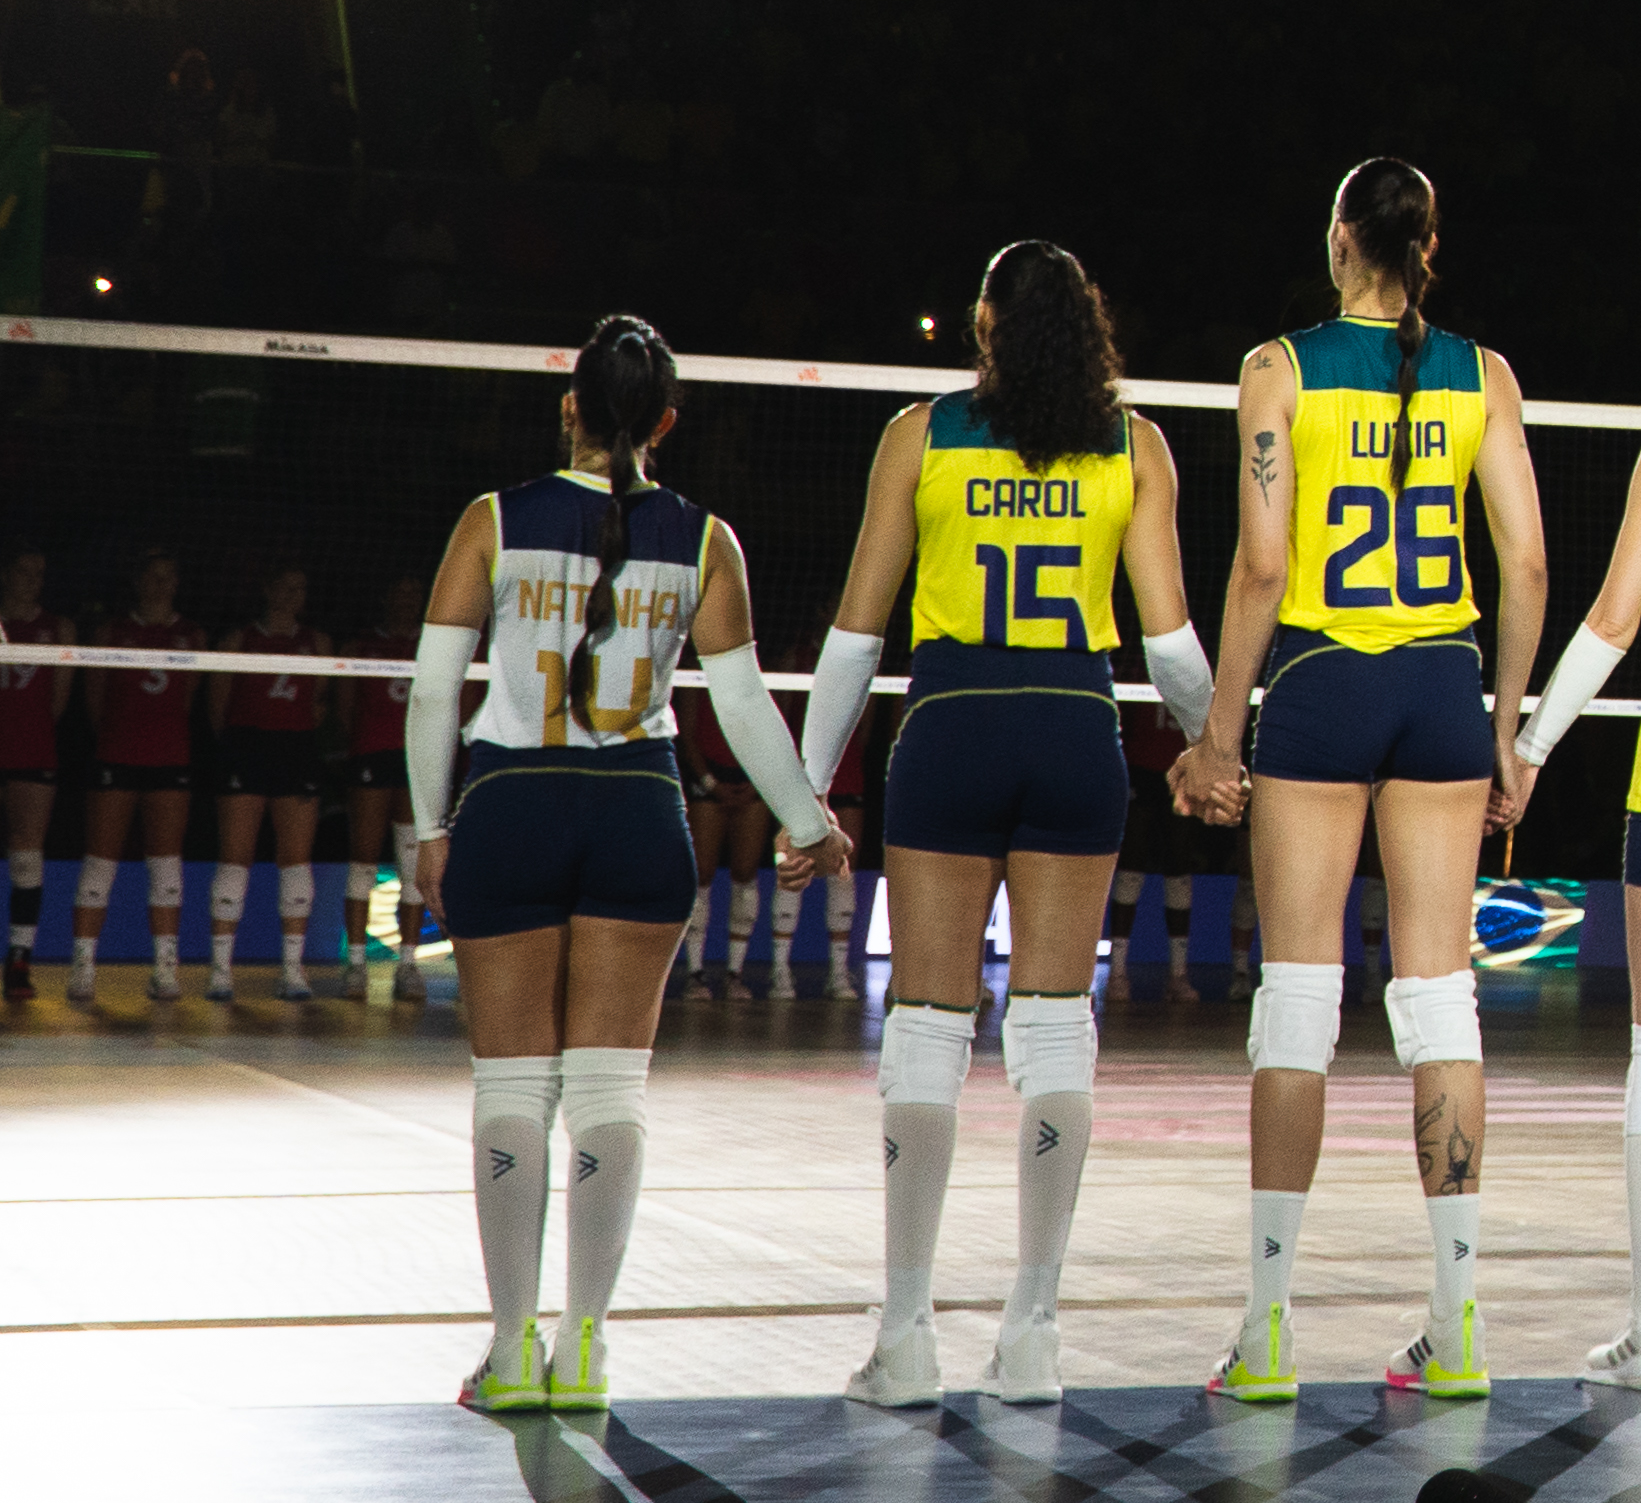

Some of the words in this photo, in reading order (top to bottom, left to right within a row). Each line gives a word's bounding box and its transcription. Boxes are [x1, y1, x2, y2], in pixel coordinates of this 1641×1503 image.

[1352, 420, 1447, 459] LUIA
[966, 478, 1087, 518] CAROL
[1324, 485, 1464, 608] 26
[518, 579, 680, 630] NATNHA
[975, 543, 1089, 649] 15
